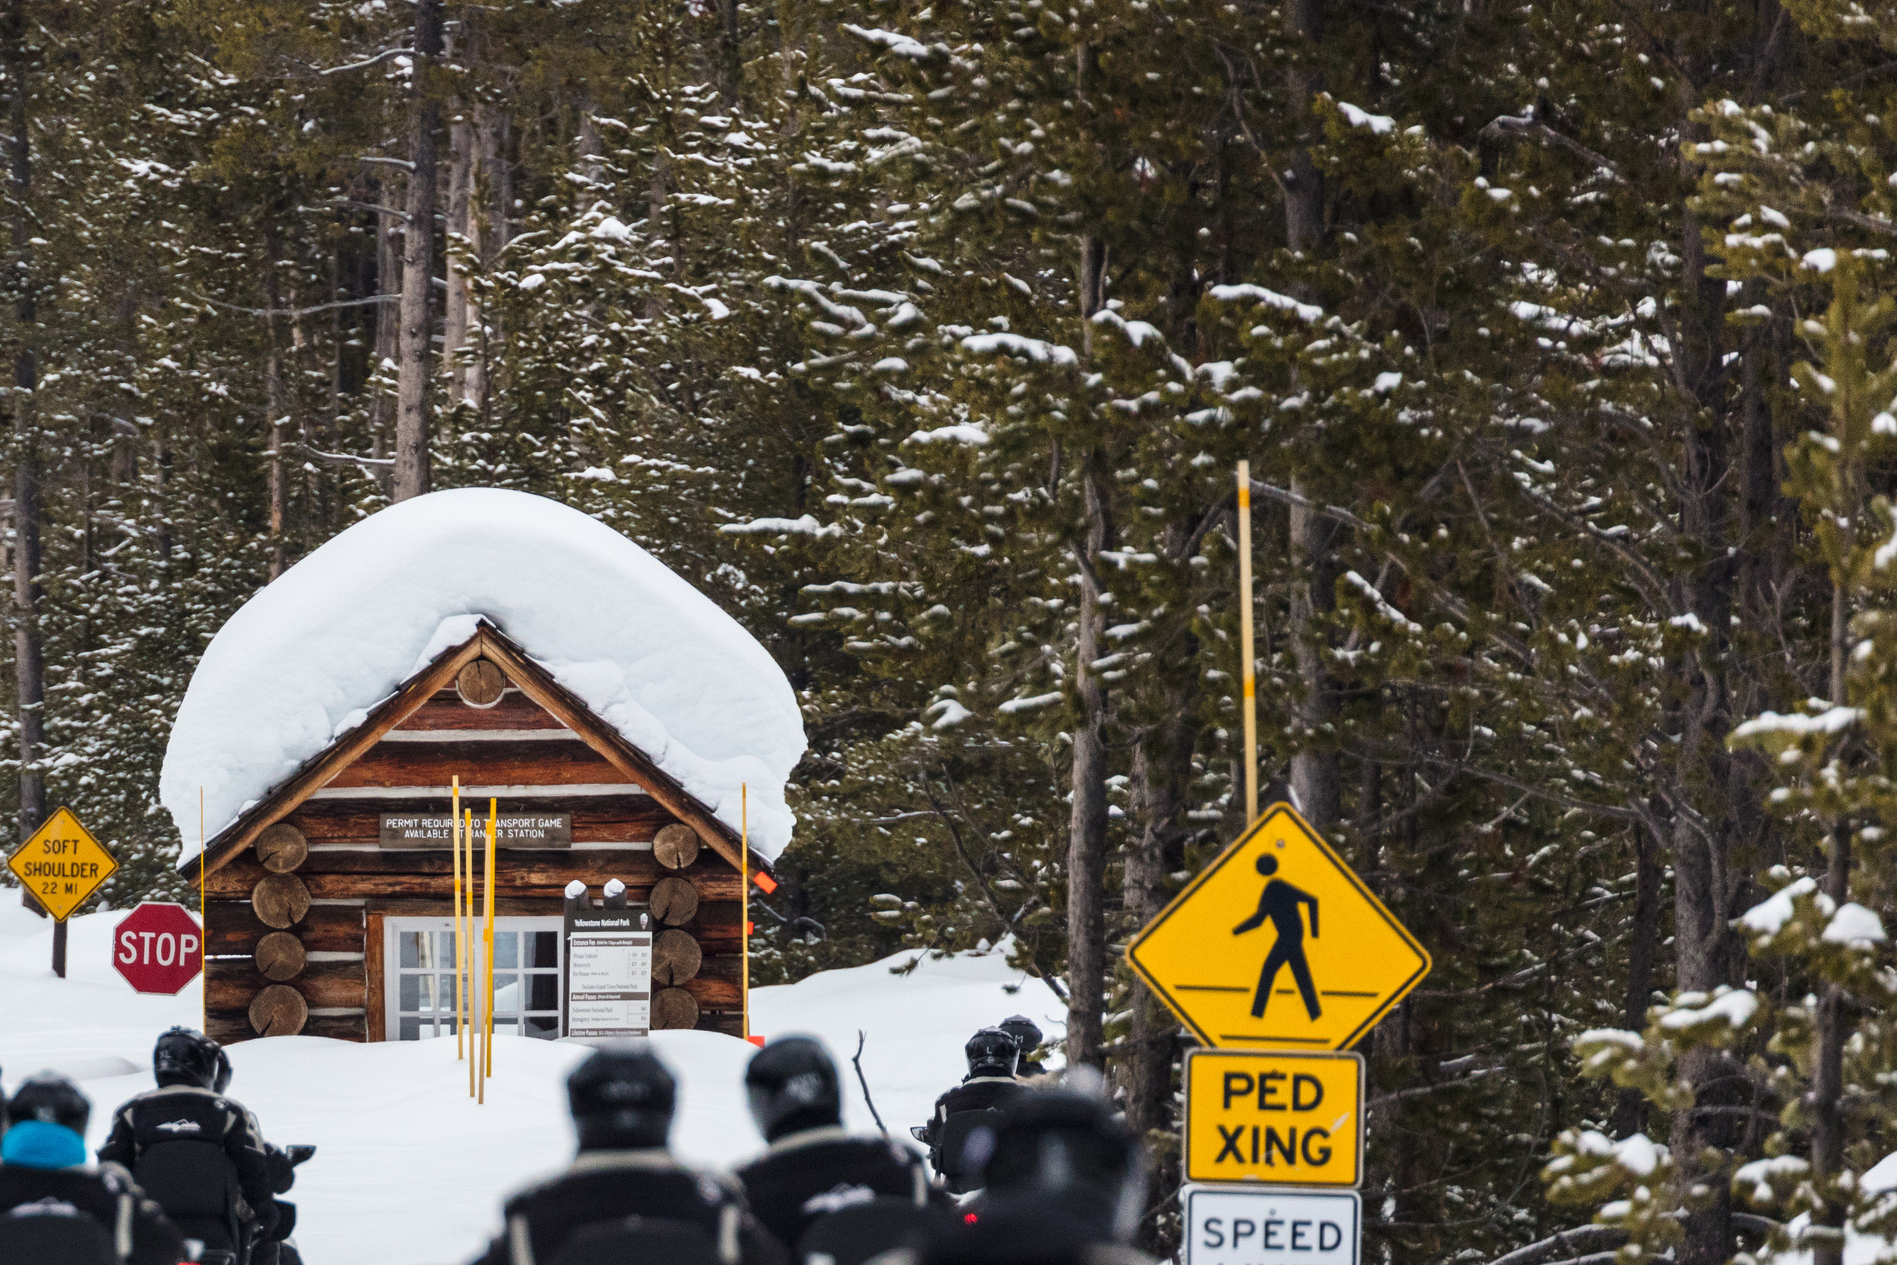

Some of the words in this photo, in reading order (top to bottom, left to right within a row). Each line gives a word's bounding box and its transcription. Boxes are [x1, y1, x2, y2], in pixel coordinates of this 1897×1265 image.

[386, 819, 418, 828] PERMIT
[422, 819, 466, 828] REQUIRD
[470, 819, 480, 828] TO
[484, 818, 536, 828] TANSPORT
[539, 818, 562, 827] GAME
[404, 829, 449, 838] AVAILABLE
[471, 829, 503, 838] RANR
[508, 829, 544, 838] STATION
[43, 840, 80, 854] SOFT
[24, 862, 98, 878] SHOULDER
[42, 882, 57, 894] 22
[65, 883, 77, 894] MI
[119, 931, 198, 966] STOP
[1015, 1034, 1023, 1044] M
[987, 1046, 992, 1054] L
[1223, 1071, 1324, 1112] PED
[1214, 1125, 1332, 1167] XING
[1203, 1217, 1342, 1251] SPEED
